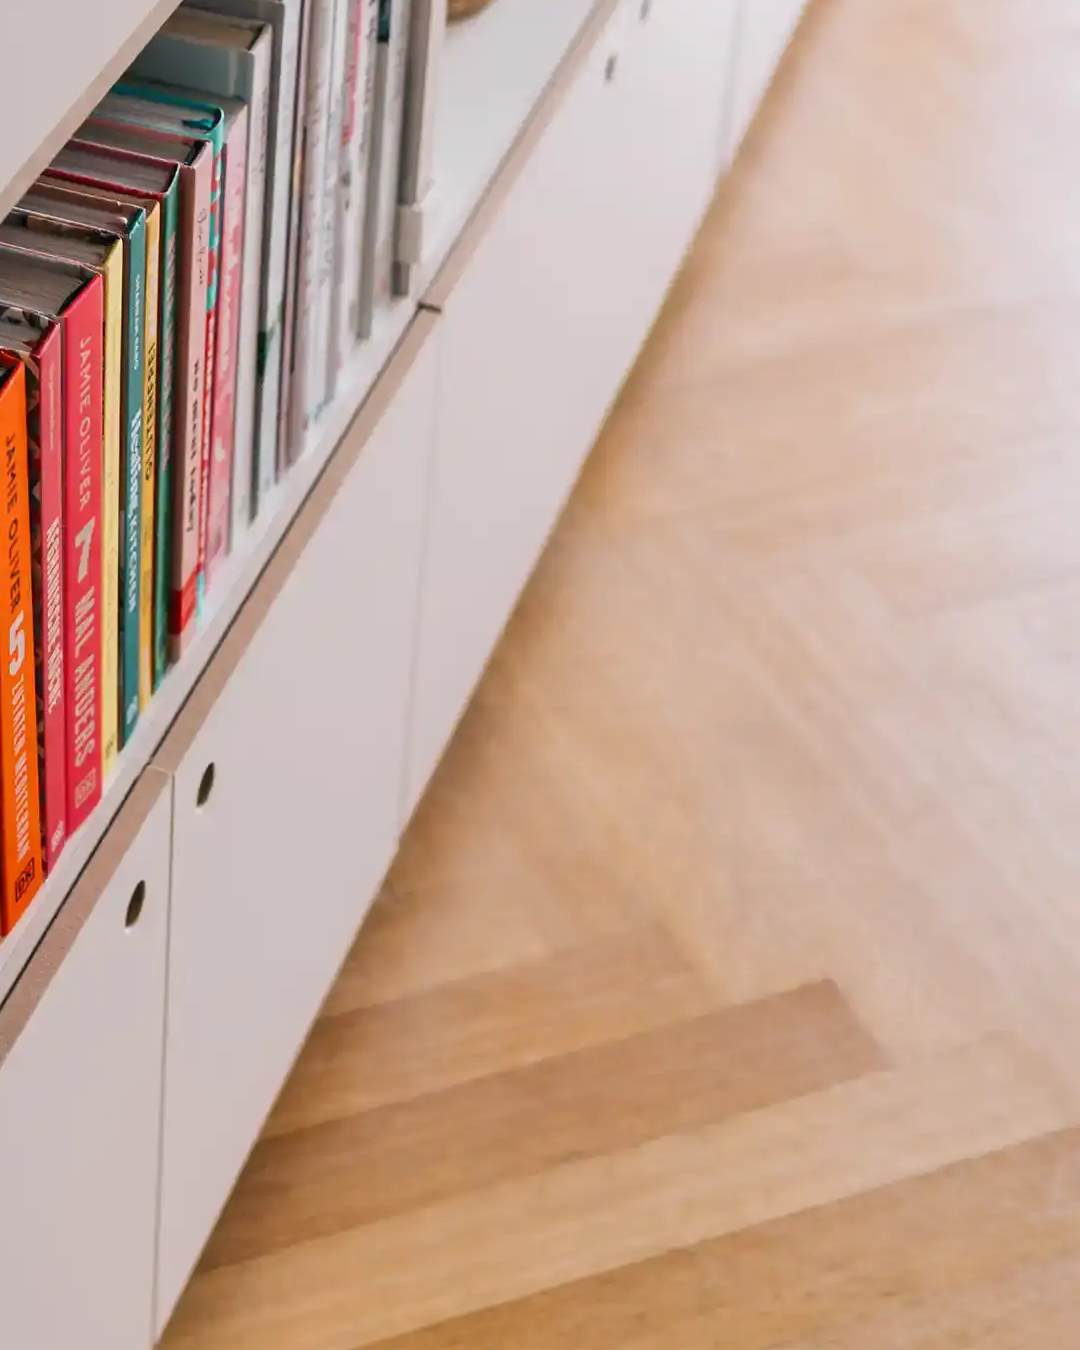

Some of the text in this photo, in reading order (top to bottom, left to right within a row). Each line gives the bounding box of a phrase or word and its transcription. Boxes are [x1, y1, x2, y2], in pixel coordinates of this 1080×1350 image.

[79, 335, 92, 512] JAMIE OLIVER
[5, 432, 21, 615] JAMIE OLIVER
[9, 609, 26, 676] 5
[47, 516, 63, 715] AFGHANISCHE KÜCHE
[74, 515, 95, 769] 7 MAL ANDERS
[11, 674, 26, 756] ZUTATEN
[15, 858, 35, 901] DK
